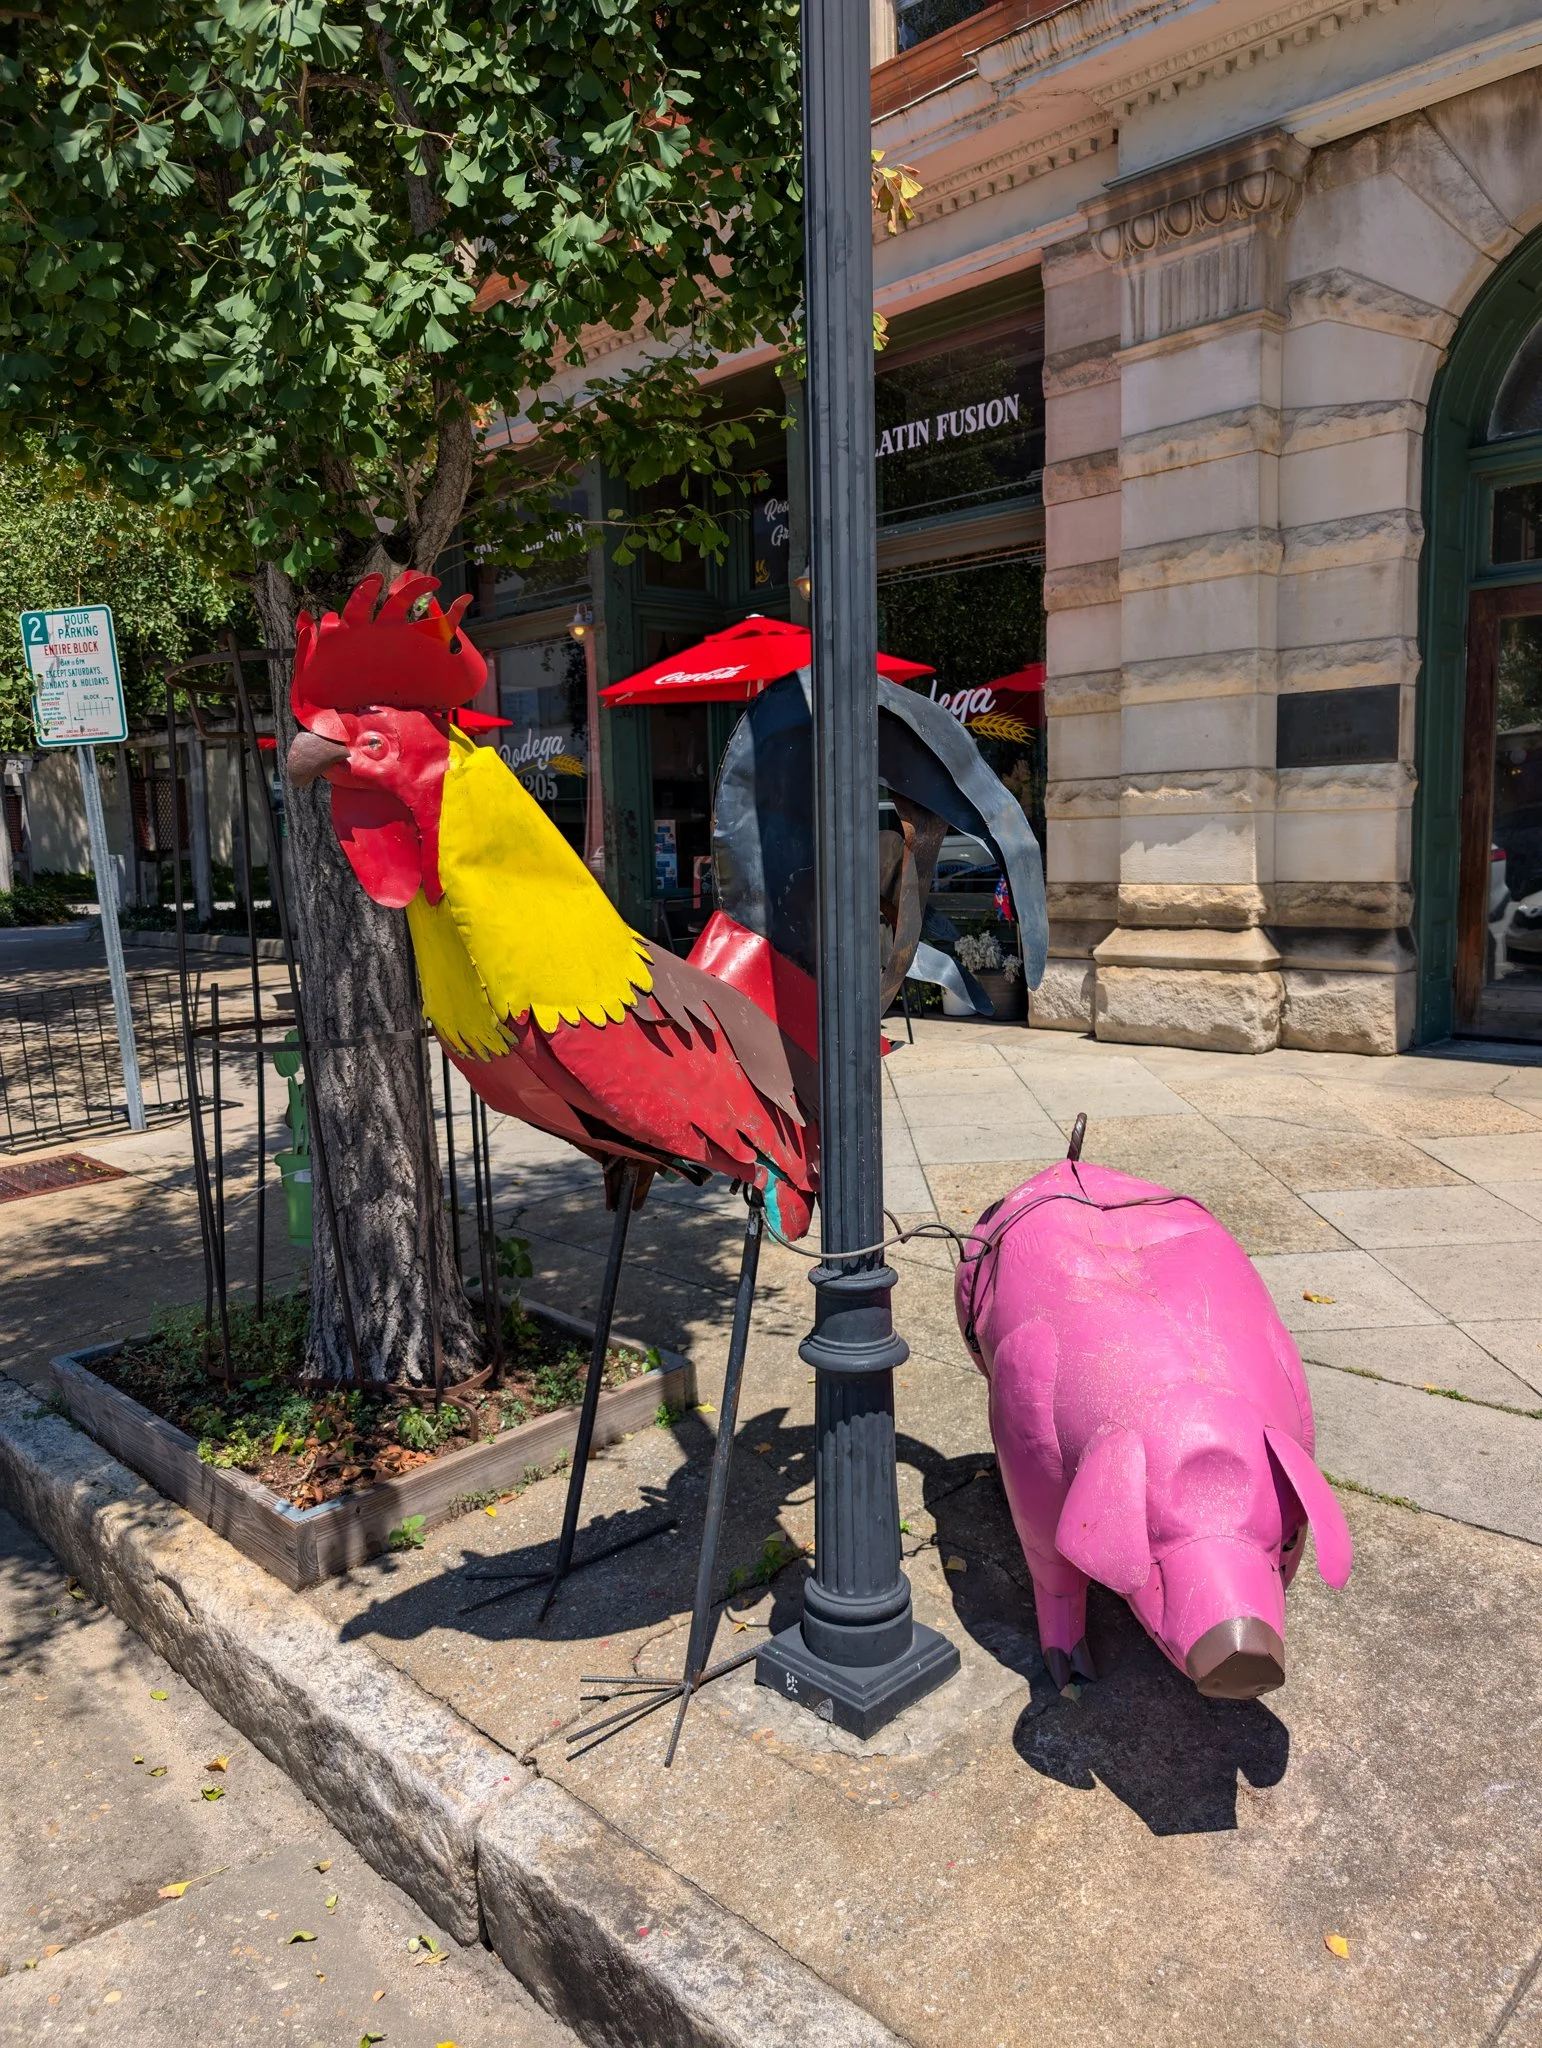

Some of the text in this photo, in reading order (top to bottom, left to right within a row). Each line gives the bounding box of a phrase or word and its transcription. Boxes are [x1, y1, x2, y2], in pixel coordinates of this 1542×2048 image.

[936, 393, 1020, 441] FUSION
[771, 524, 790, 546] Gr
[28, 617, 43, 641] 2
[63, 613, 90, 626] HOUR
[57, 625, 99, 639] PARKING
[44, 641, 99, 656] ENTIRE BLOCK
[41, 676, 109, 690] SUNDAYS & HOLIDAYS
[45, 669, 67, 679] EXCEPT
[928, 679, 996, 724] ega
[498, 728, 566, 771] Bodega
[520, 773, 558, 801] 205
